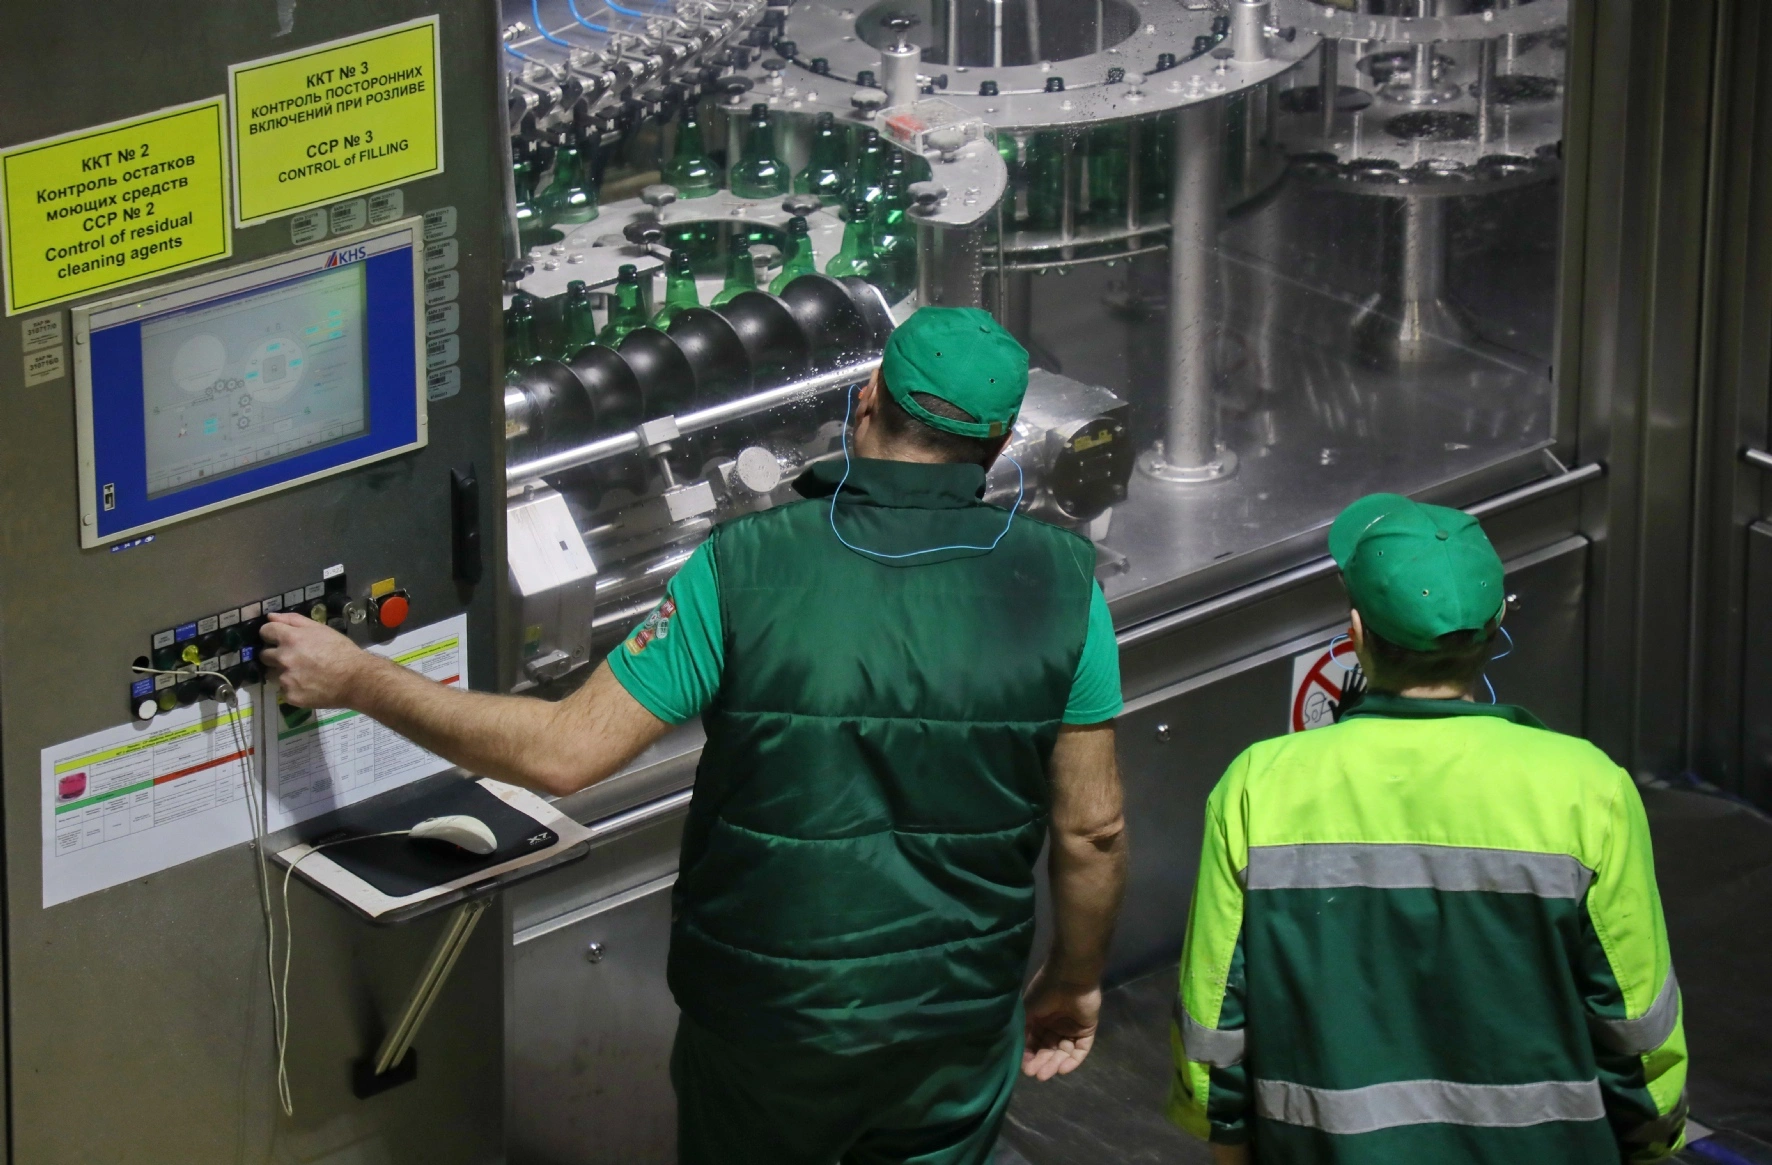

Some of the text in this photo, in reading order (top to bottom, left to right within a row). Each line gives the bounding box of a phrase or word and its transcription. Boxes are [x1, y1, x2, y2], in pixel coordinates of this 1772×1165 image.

[251, 65, 423, 119] КОНТРОЛЬ ПОСТОРОННИХ
[306, 61, 369, 89] ККТ № 3
[249, 80, 426, 135] ВКЛЮЧЕНИЙ ПРИ РОЗЛИВЕ
[81, 143, 149, 172] ККТ № 2
[278, 139, 409, 183] CONTROL of FILLING
[344, 134, 360, 149] №
[365, 130, 373, 143] 3
[36, 155, 195, 204] Контроль остатков
[46, 176, 189, 222] моющих средств
[123, 207, 141, 222] №
[146, 202, 155, 216] 2
[45, 211, 193, 262] Control of residual
[57, 236, 183, 279] cleaning agents
[339, 246, 366, 264] KHS
